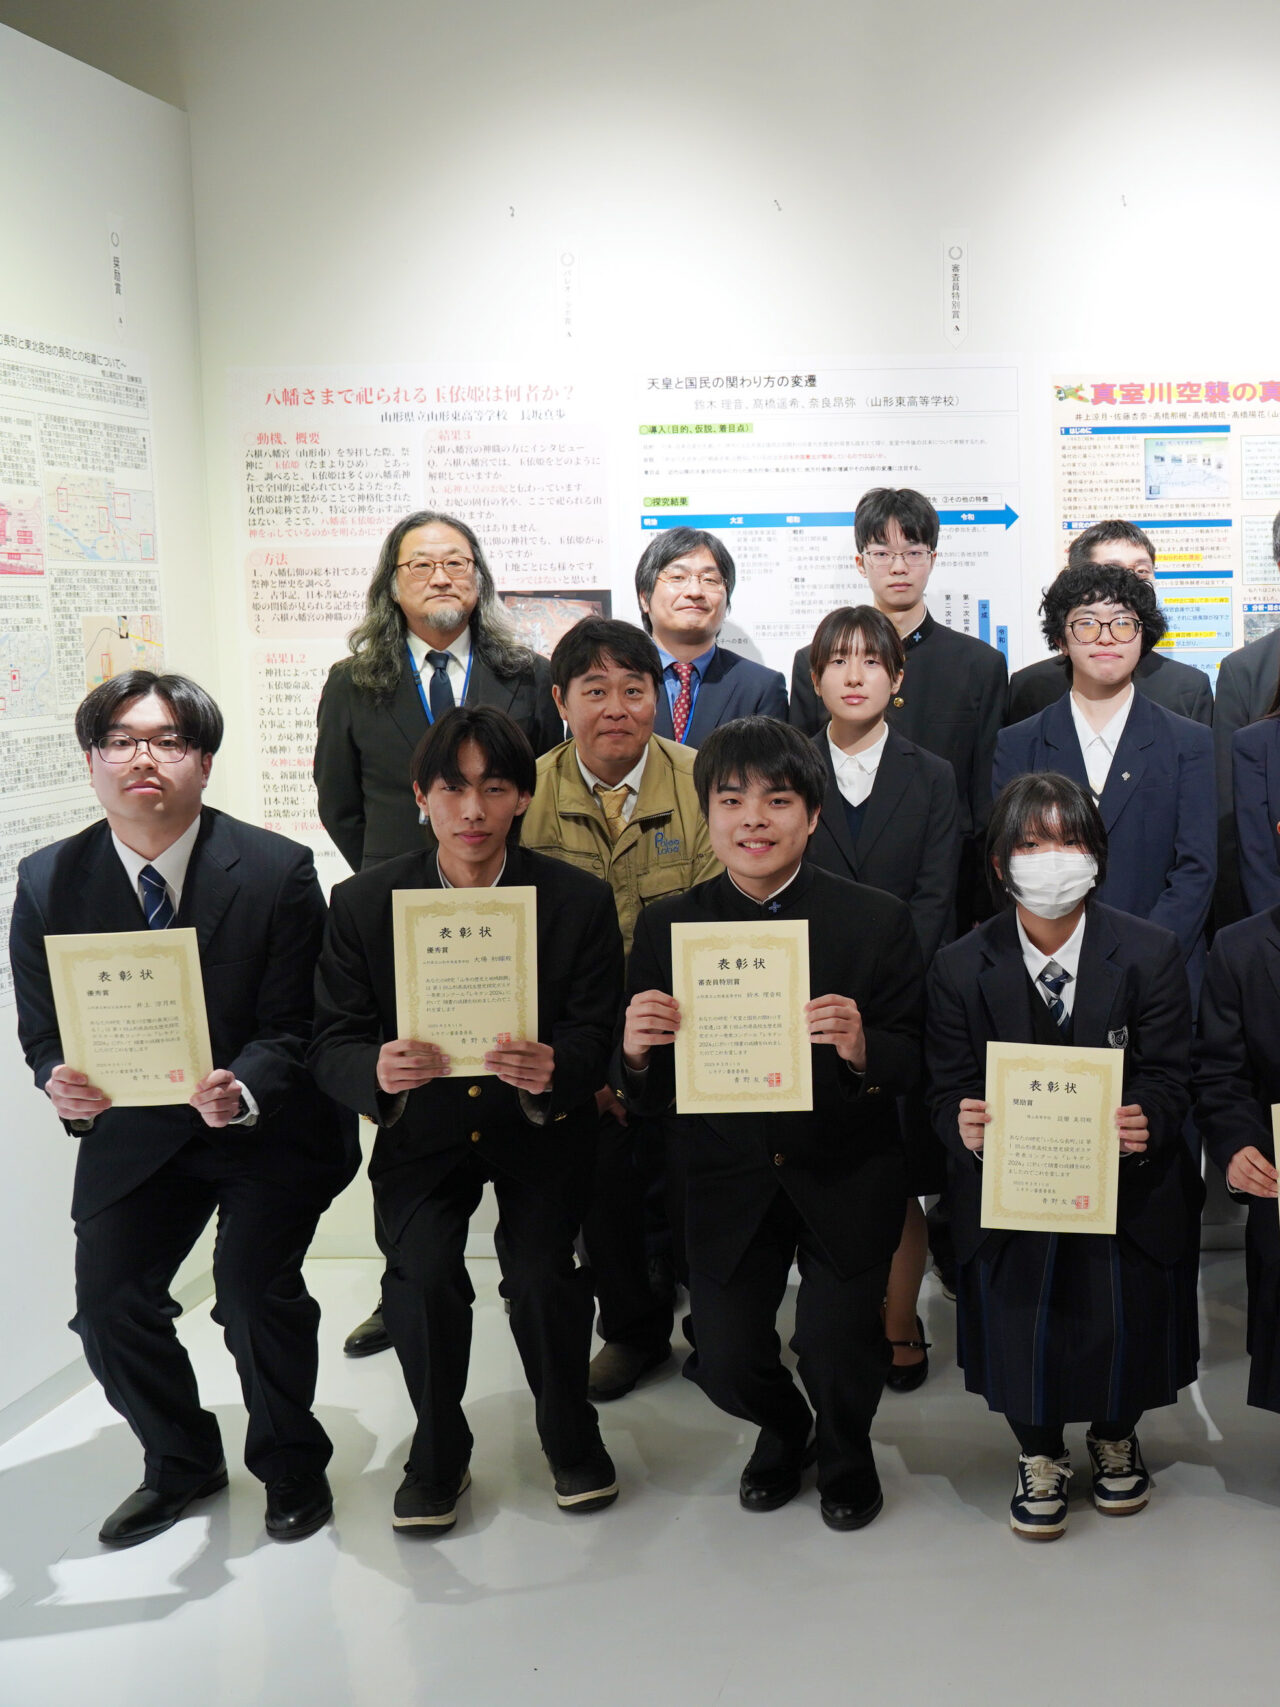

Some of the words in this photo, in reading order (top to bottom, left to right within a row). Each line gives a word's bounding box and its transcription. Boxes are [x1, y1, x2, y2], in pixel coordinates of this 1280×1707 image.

[647, 374, 818, 390] 天皇と国民の関わり方の変遷
[381, 409, 508, 423] 山形県立山形東高等学校
[960, 513, 975, 521] 令和
[264, 552, 289, 566] 方法
[439, 926, 493, 939] 表彰状
[718, 957, 766, 970] 表彰状
[98, 968, 155, 983] 表彰状
[1029, 1079, 1078, 1094] 表彰状
